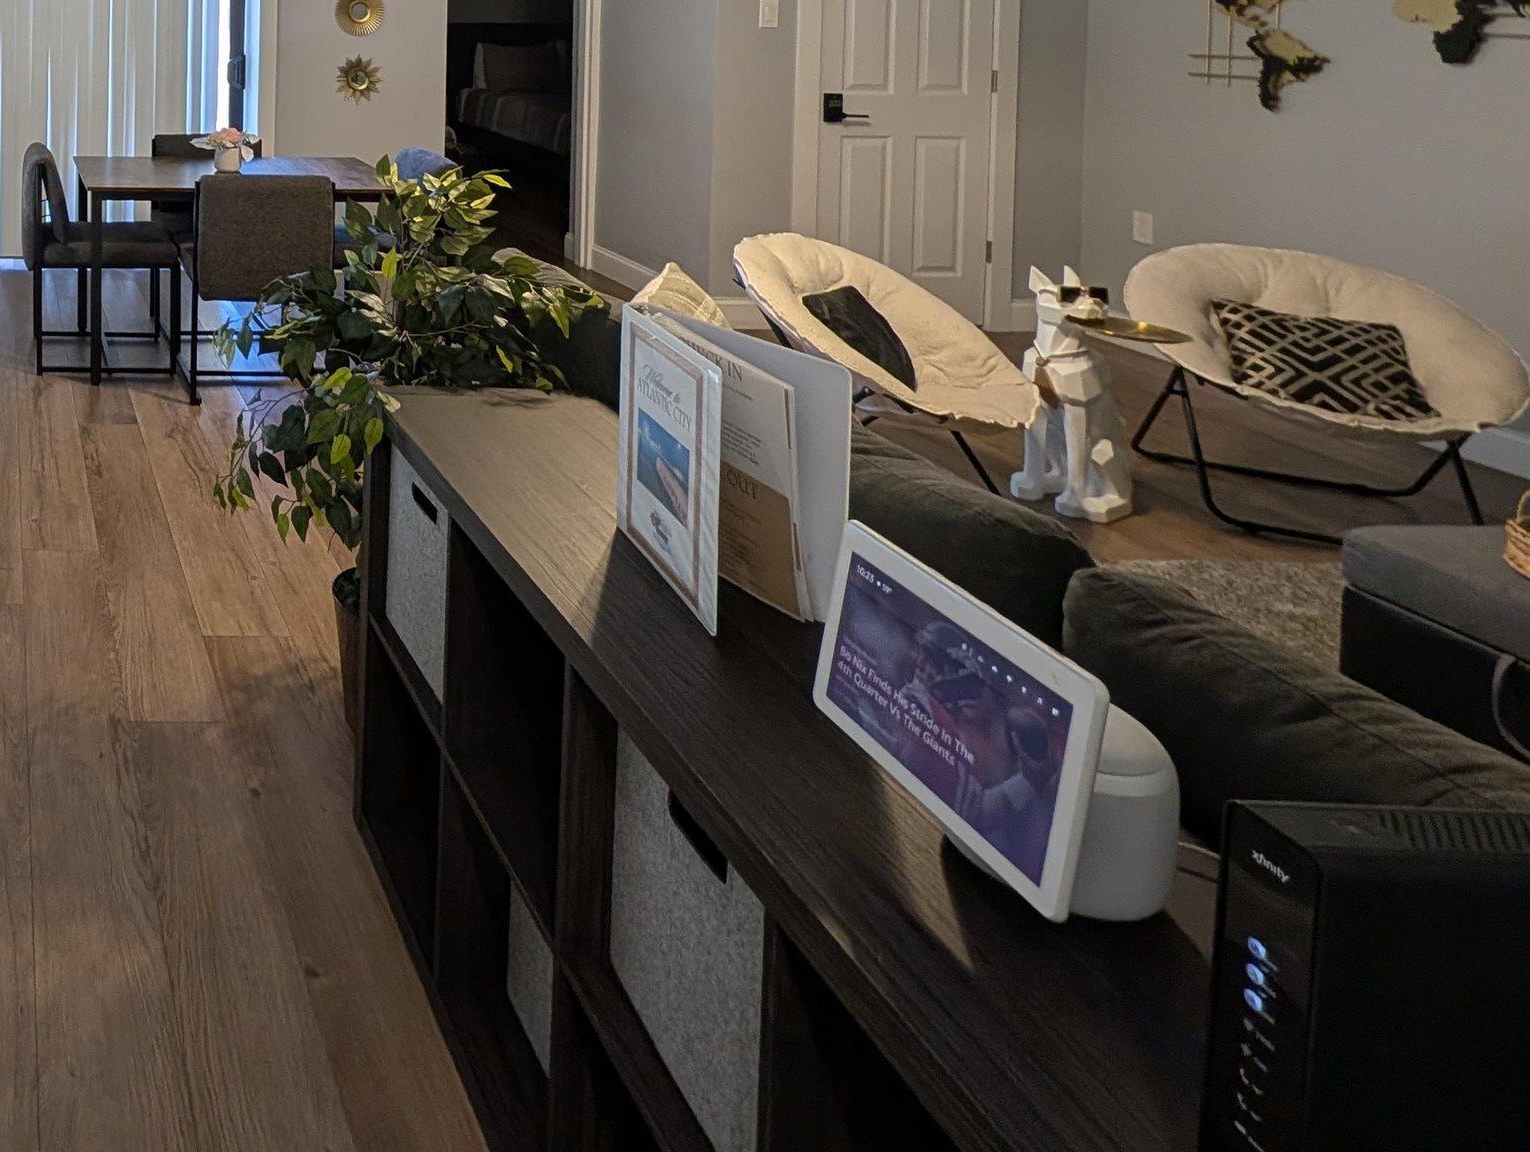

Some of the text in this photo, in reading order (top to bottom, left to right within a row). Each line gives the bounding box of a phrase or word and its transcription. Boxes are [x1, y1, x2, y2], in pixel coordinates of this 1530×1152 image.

[726, 360, 743, 382] IN
[637, 376, 692, 433] ATLANTIC CITY
[726, 469, 758, 500] OUT
[854, 673, 888, 707] Quarter
[903, 713, 921, 737] The
[923, 732, 956, 766] Giants
[867, 666, 892, 695] Finds
[910, 704, 941, 735] Stride
[941, 729, 952, 745] In
[955, 738, 975, 765] The
[1252, 849, 1290, 883] xfinity
